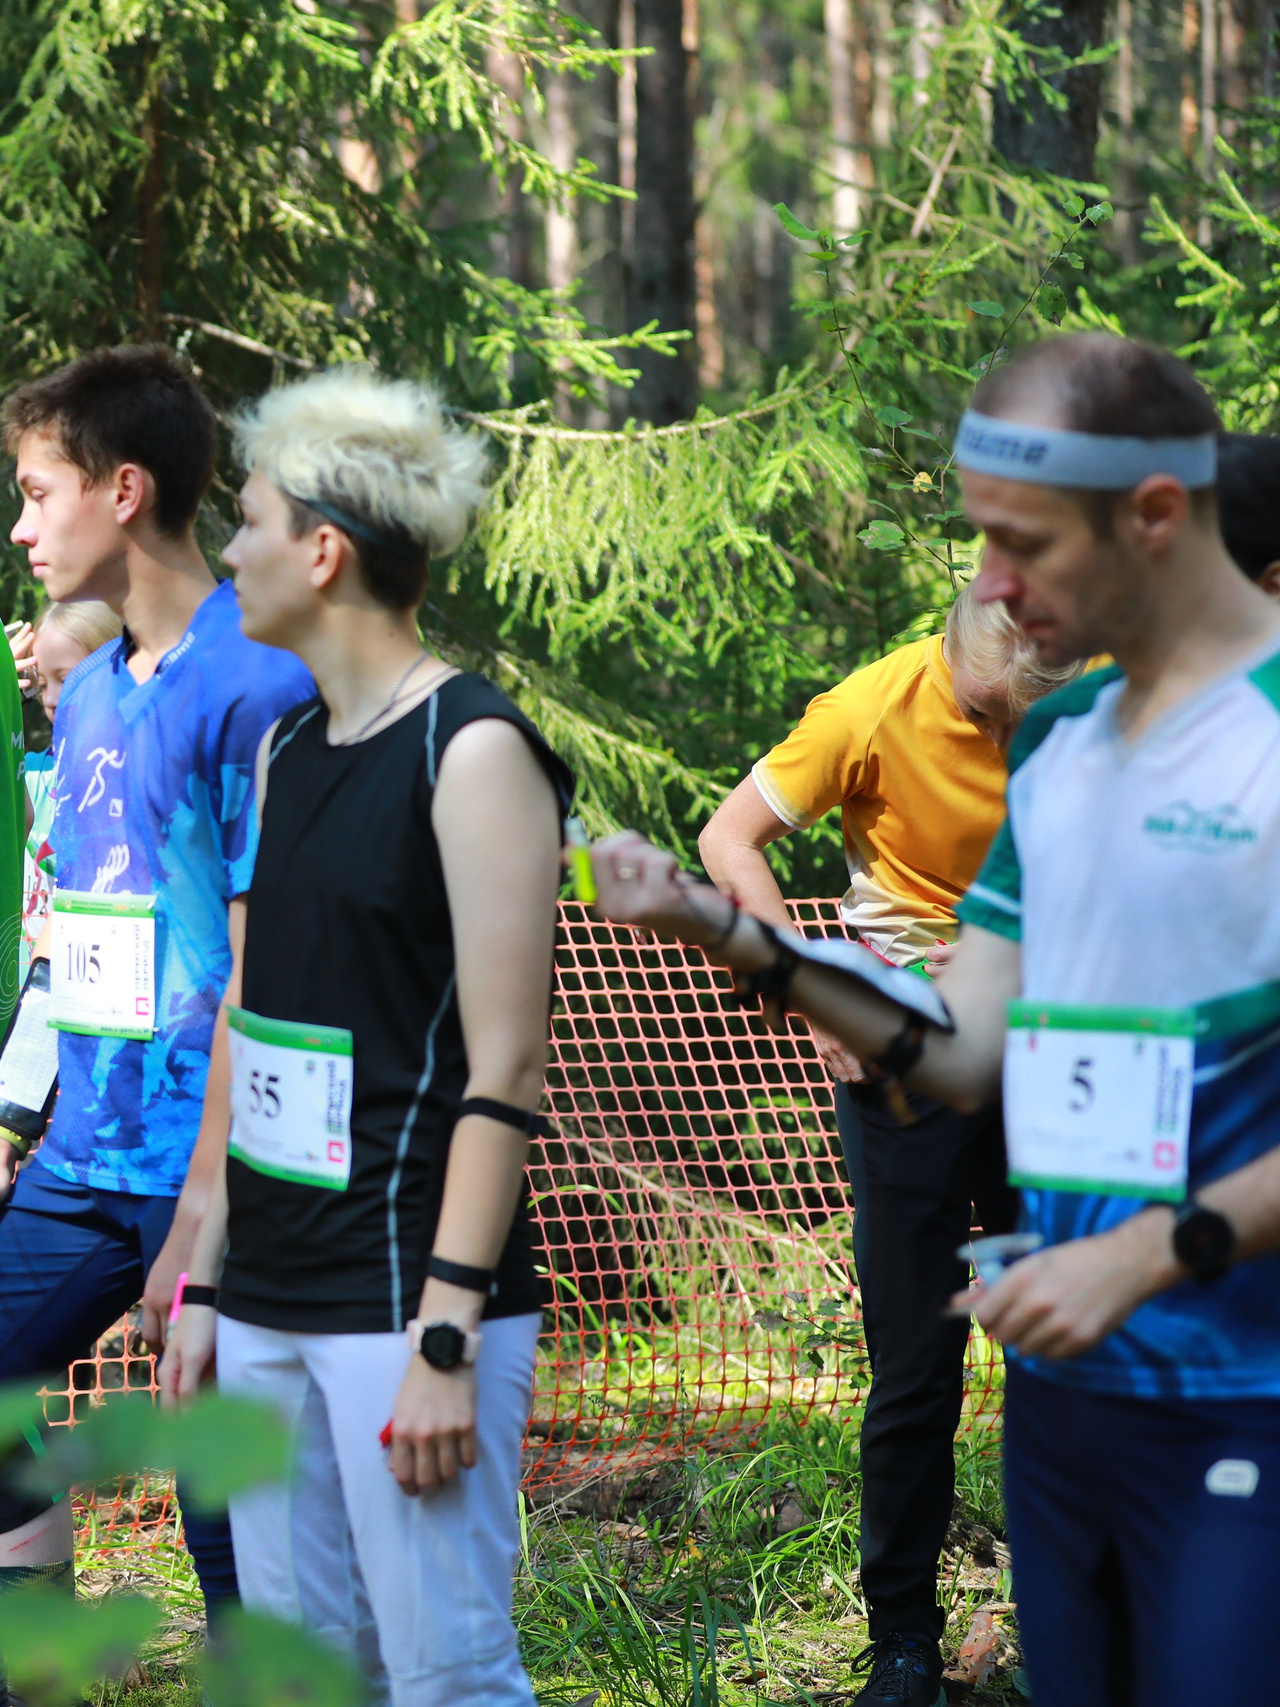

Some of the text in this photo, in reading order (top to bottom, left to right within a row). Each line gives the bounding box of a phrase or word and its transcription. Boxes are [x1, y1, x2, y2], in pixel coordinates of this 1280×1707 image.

[66, 941, 101, 984] 105
[249, 1070, 283, 1119] 55
[1069, 1057, 1096, 1113] 5
